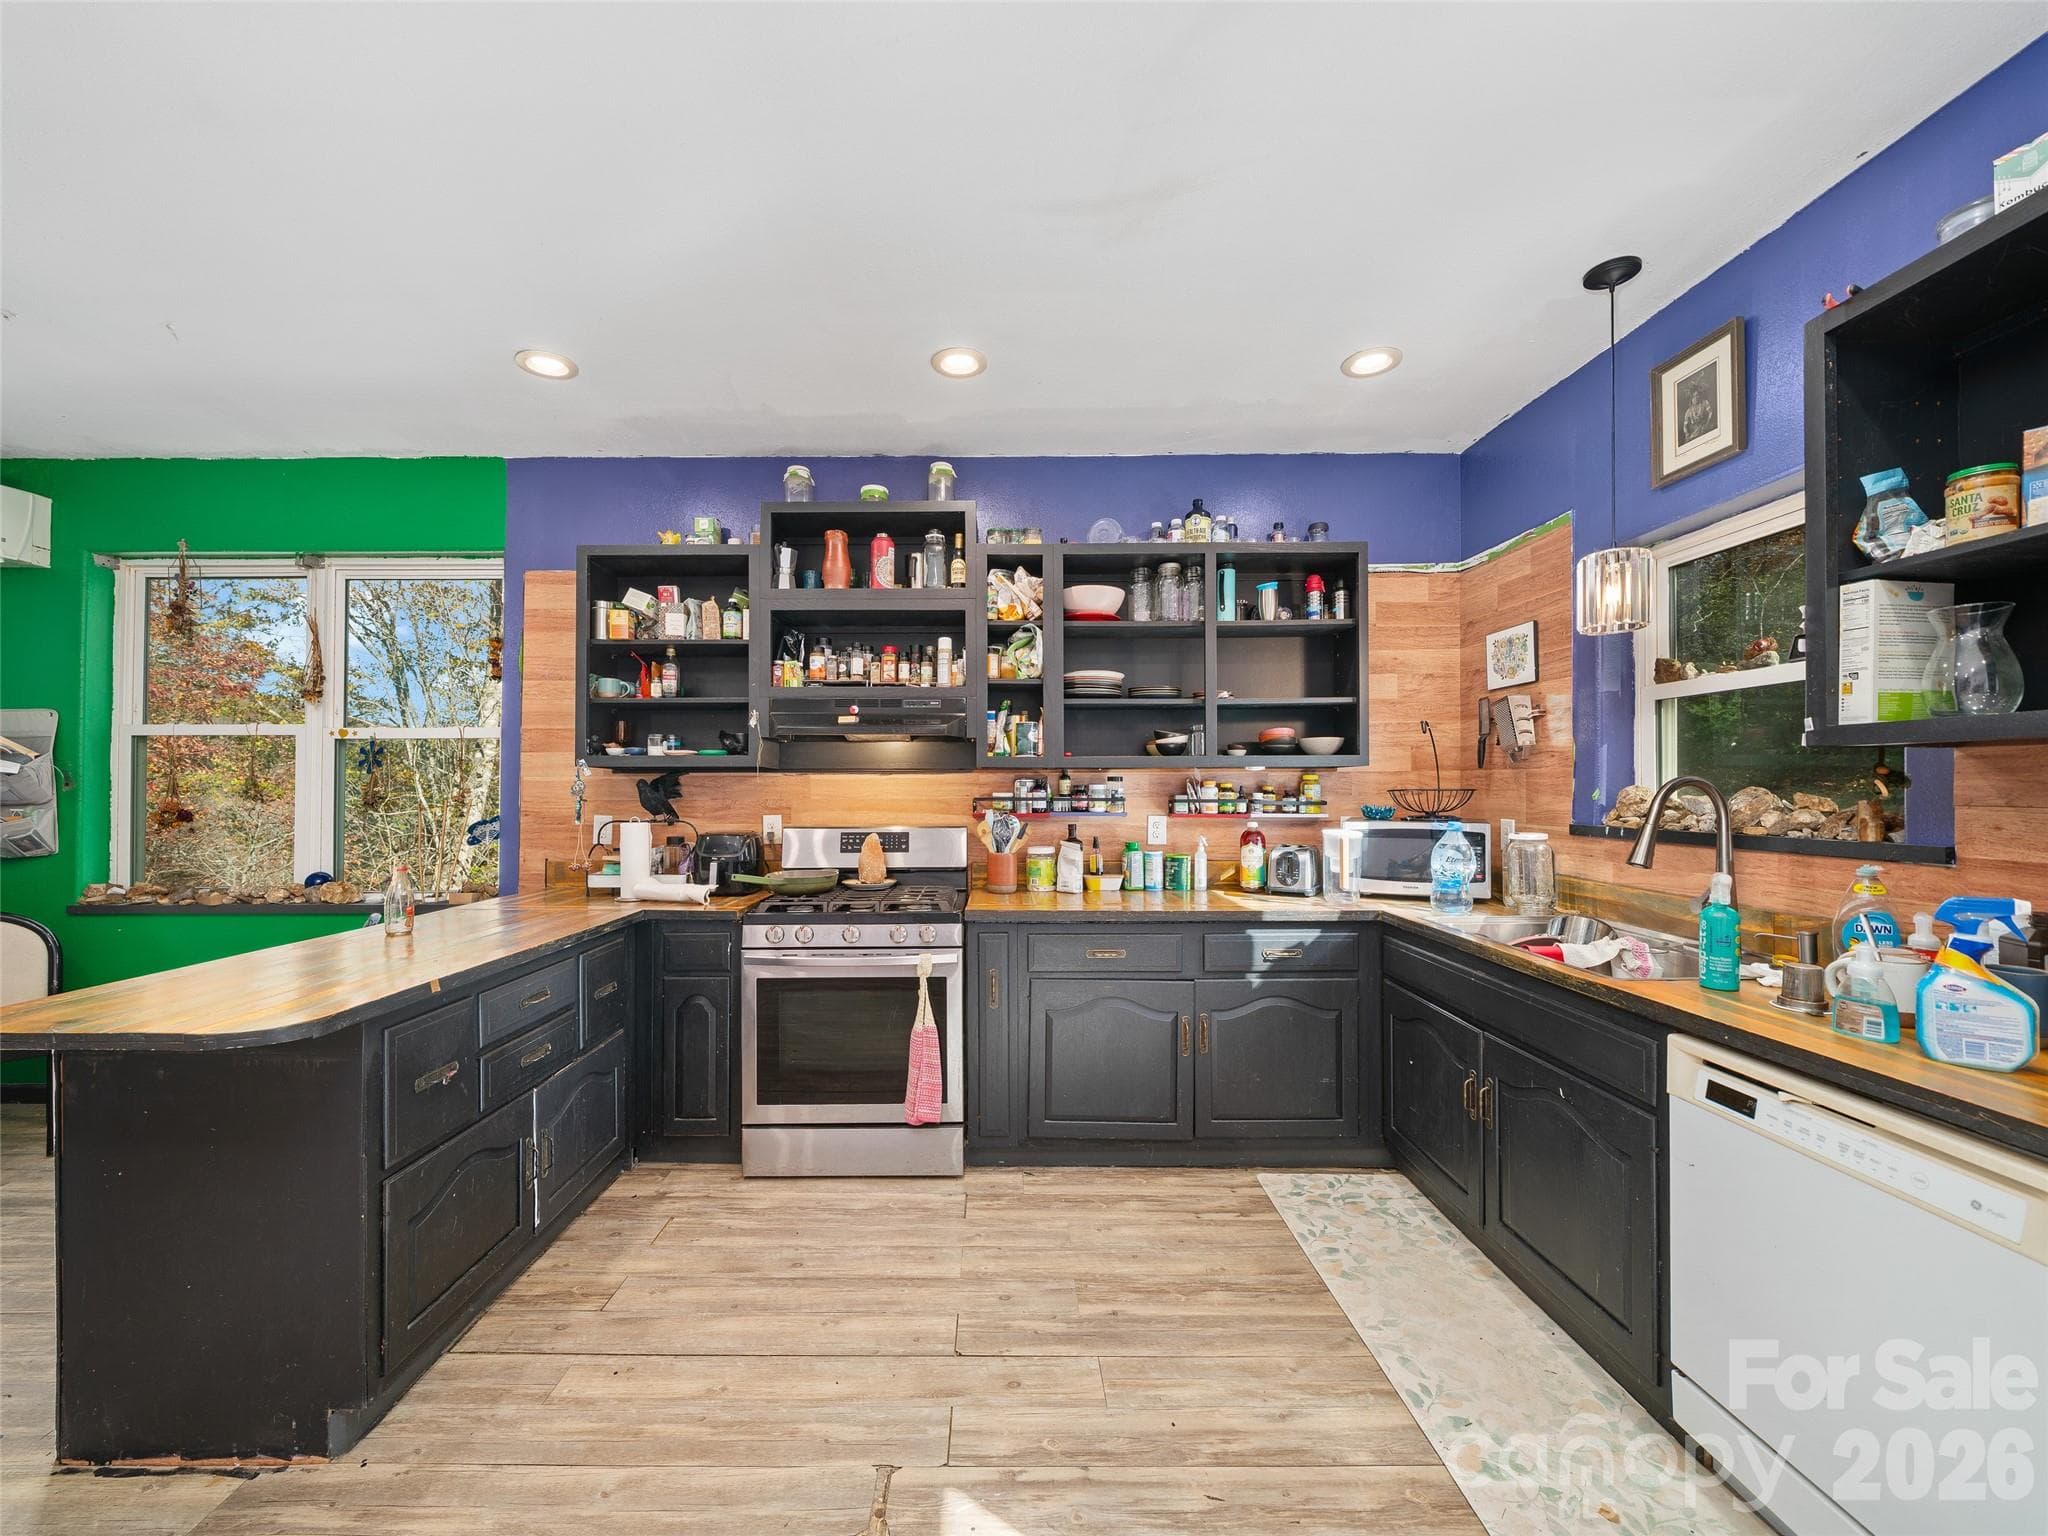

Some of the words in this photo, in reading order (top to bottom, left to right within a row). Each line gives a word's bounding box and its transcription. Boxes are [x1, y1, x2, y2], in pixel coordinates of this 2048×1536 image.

[1949, 492, 1983, 508] SANTA
[1951, 502, 1980, 517] CRUZ
[1854, 923, 1893, 935] DWN
